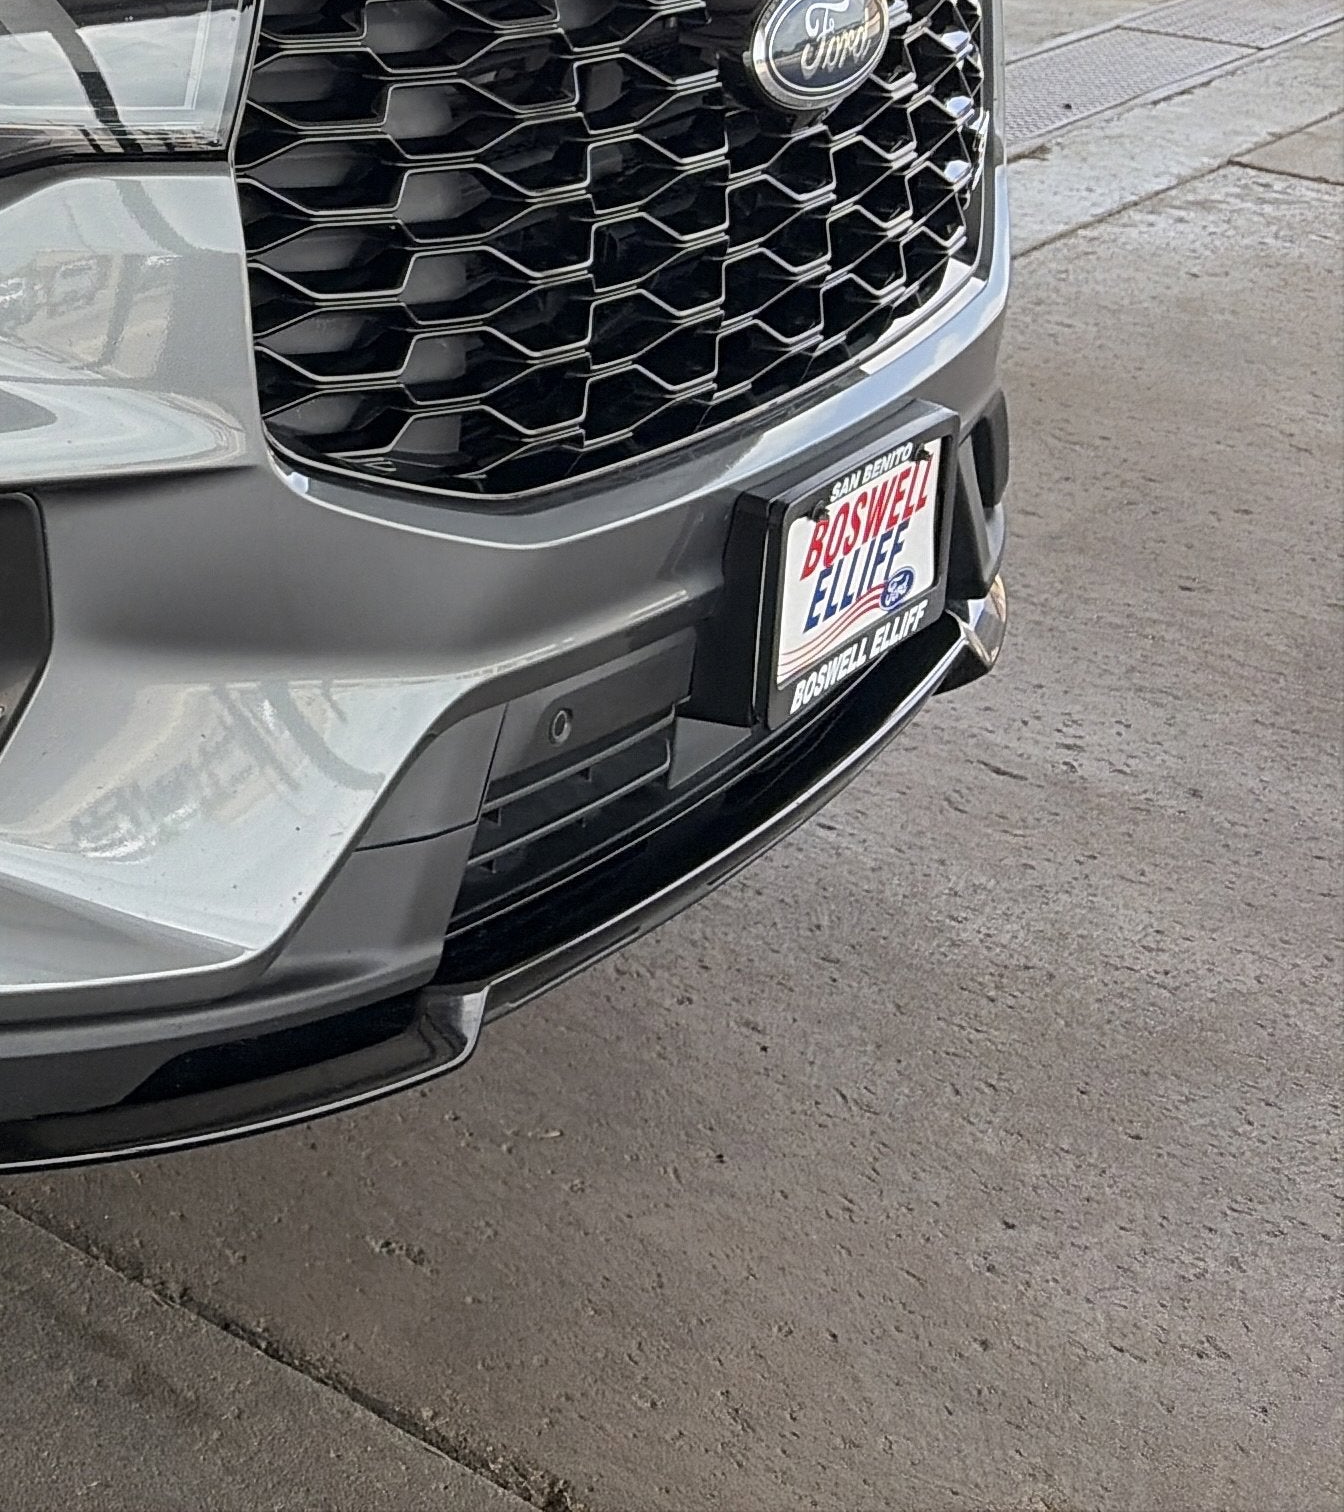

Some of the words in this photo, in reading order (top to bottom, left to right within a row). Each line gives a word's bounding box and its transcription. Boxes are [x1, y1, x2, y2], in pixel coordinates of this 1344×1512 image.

[799, 453, 934, 581] BOSWELL
[829, 470, 860, 503] SAN
[861, 442, 913, 486] BENITO
[802, 519, 911, 634] ELLIFF
[789, 636, 868, 715] BOSWELL
[868, 598, 929, 661] ELLIFF
